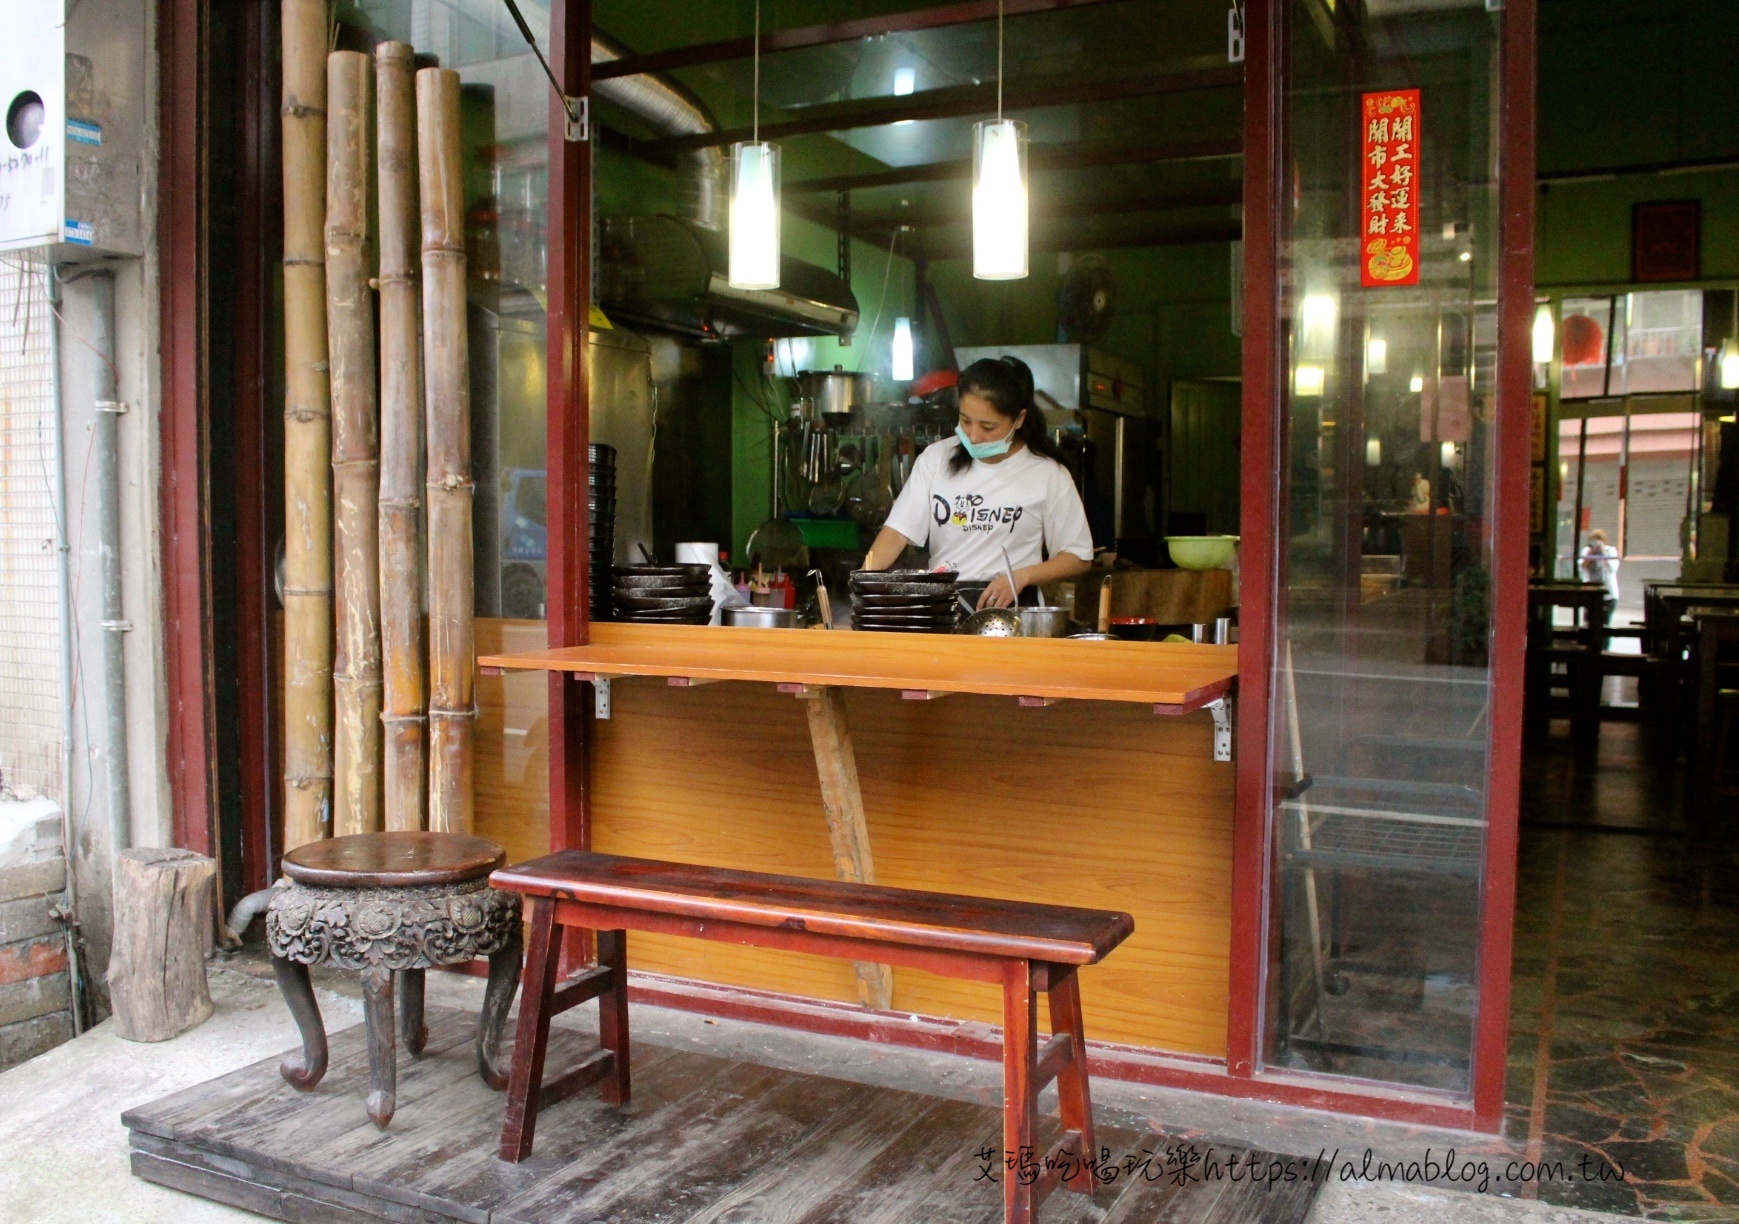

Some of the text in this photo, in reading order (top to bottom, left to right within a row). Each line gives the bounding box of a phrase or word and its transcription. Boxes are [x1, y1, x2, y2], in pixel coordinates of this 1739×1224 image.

[1367, 117, 1390, 235] 開市大發財
[962, 524, 994, 535] DISNEY
